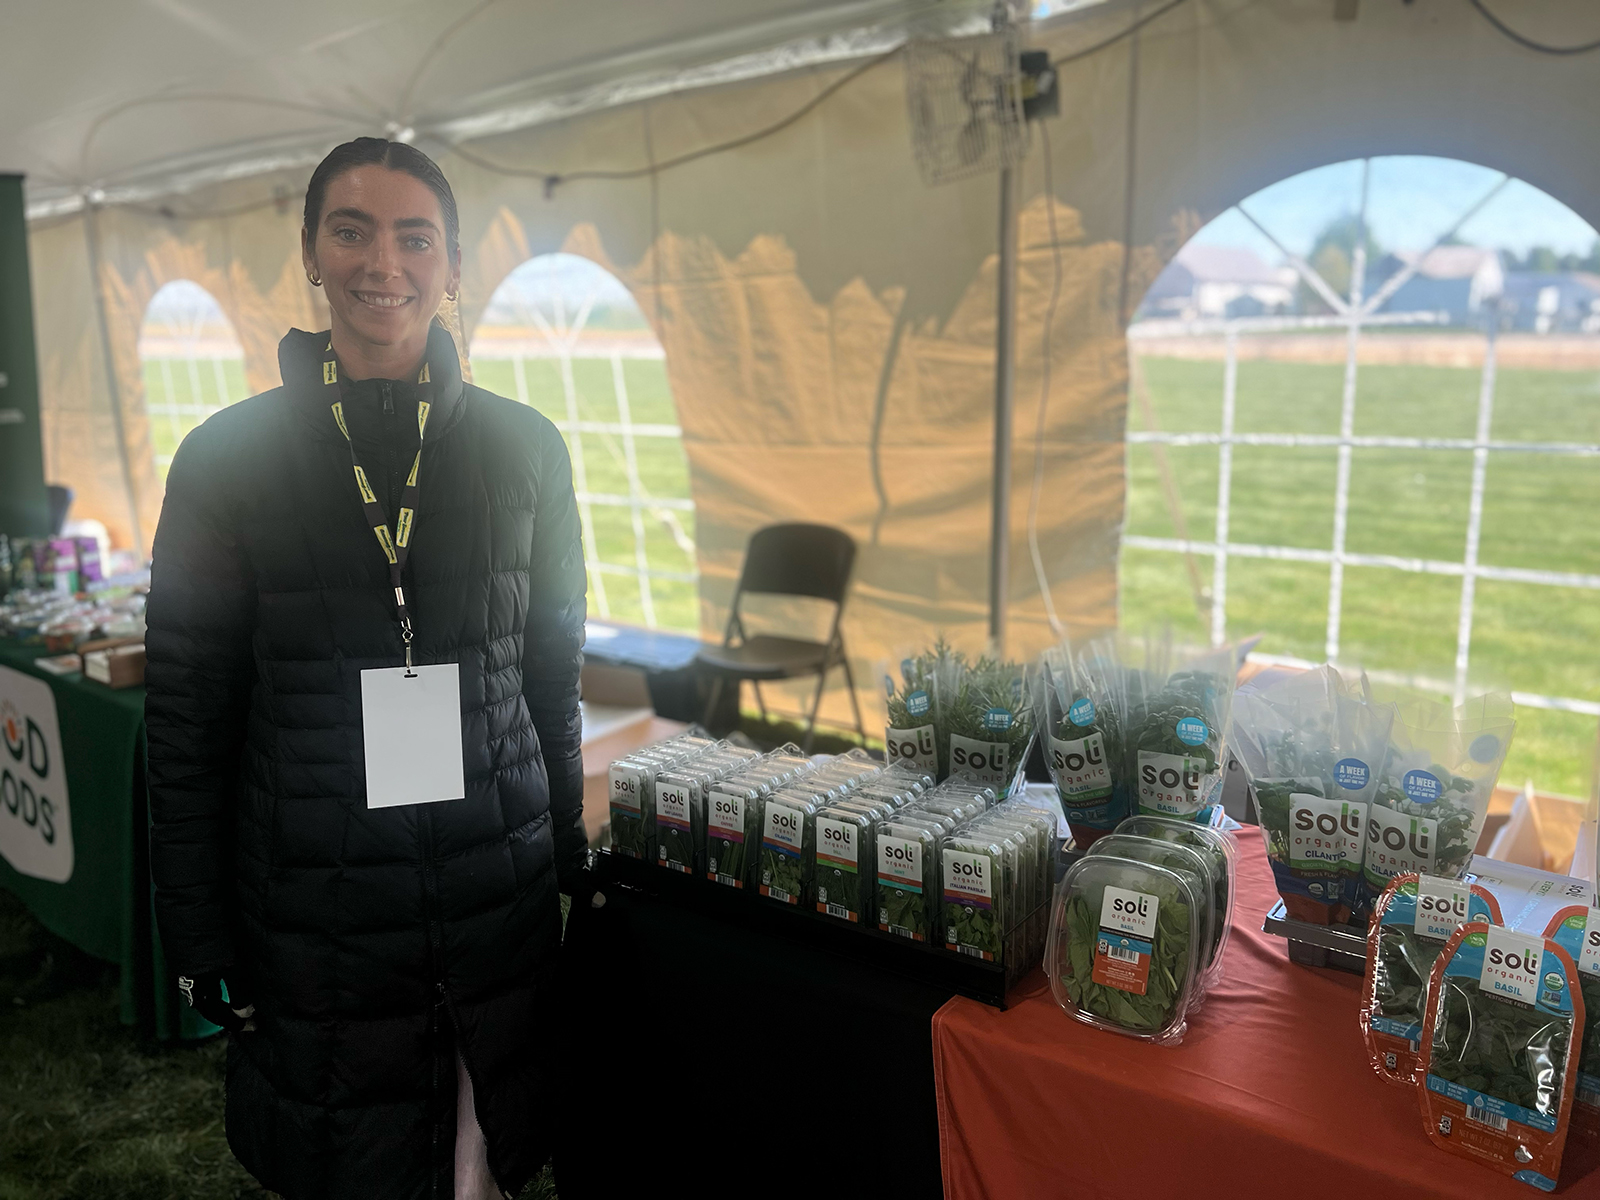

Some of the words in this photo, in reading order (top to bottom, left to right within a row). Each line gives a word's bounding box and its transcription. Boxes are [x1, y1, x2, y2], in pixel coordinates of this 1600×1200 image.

[1078, 702, 1092, 714] WEEK
[1187, 724, 1204, 733] WEEK
[888, 730, 932, 759] soli
[953, 744, 1004, 772] soli
[1054, 739, 1102, 772] soli
[1142, 758, 1198, 790] soli
[1340, 764, 1345, 774] A
[1346, 766, 1366, 776] WEEK
[615, 778, 634, 794] soli
[1069, 784, 1092, 794] BASIL
[1408, 775, 1414, 785] A
[1416, 776, 1436, 788] WEEK
[662, 790, 684, 806] soli
[1142, 788, 1198, 802] organic
[716, 799, 738, 816] soli
[1157, 803, 1180, 814] BASIL
[772, 813, 796, 830] soli
[1295, 802, 1360, 838] soli
[824, 826, 850, 844] soli
[1368, 818, 1428, 858] soli
[824, 840, 850, 852] organic
[1295, 837, 1358, 850] organic
[885, 843, 914, 862] soli
[886, 860, 914, 871] organic
[952, 859, 983, 878] soli
[950, 882, 966, 890] ITALIAN
[967, 885, 986, 894] PARSLEY
[952, 876, 983, 887] organic
[1112, 896, 1148, 918] soli
[1421, 894, 1465, 917] soli
[1112, 913, 1146, 926] organic
[1120, 924, 1134, 932] BASIL
[1428, 926, 1452, 937] BASIL
[1489, 948, 1538, 975] soli
[1487, 966, 1535, 985] organic
[1494, 982, 1522, 996] BASIL
[1484, 993, 1513, 1005] PESTICIDE
